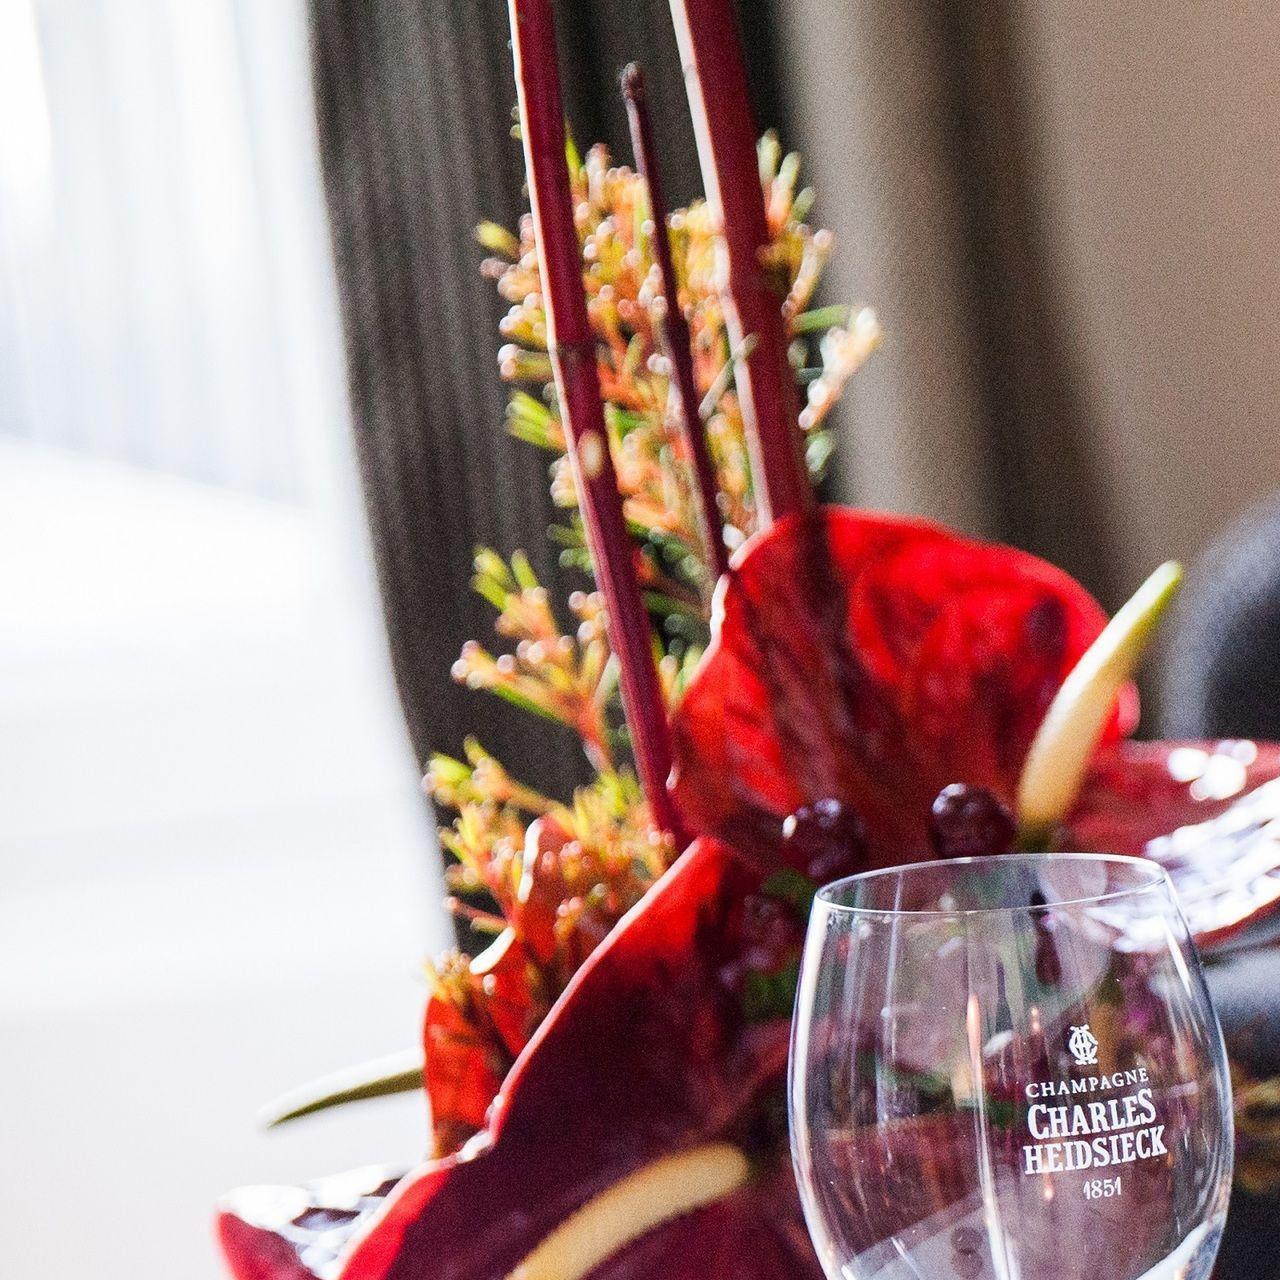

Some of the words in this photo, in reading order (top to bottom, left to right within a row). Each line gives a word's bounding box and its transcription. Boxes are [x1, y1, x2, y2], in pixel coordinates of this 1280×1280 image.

[1025, 1067, 1149, 1098] CHAMPAGNE
[1027, 1088, 1156, 1140] CHARLES
[1023, 1125, 1168, 1175] HEIDSIECK
[1083, 1176, 1122, 1200] 1851
